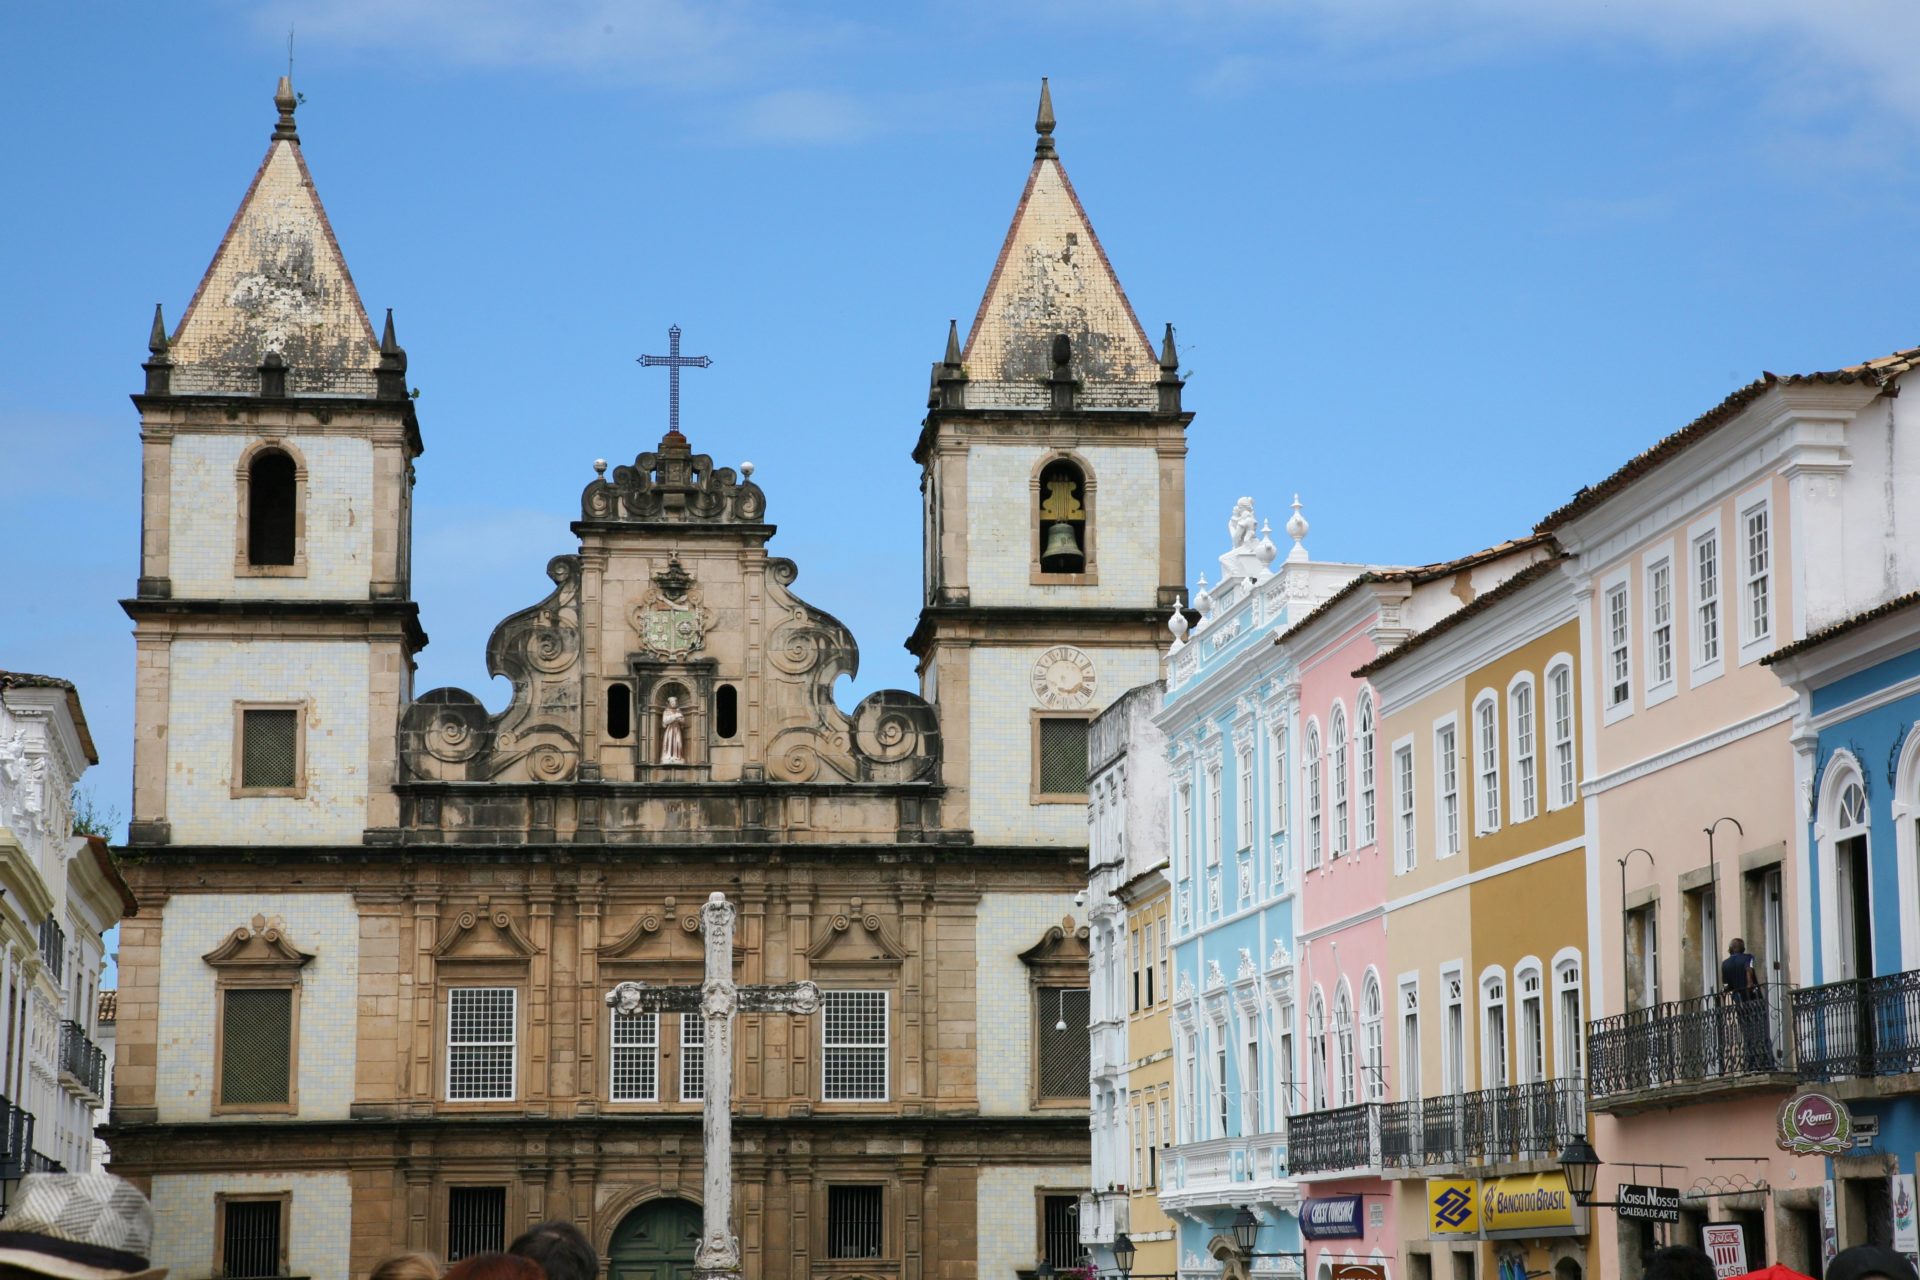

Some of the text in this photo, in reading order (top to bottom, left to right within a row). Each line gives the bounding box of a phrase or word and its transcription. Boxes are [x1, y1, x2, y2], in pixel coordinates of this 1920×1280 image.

[1497, 1188, 1566, 1214] BANCO DO BRASIL
[1647, 1187, 1679, 1208] Nossa
[1619, 1206, 1678, 1220] GALERIA DE ARTE
